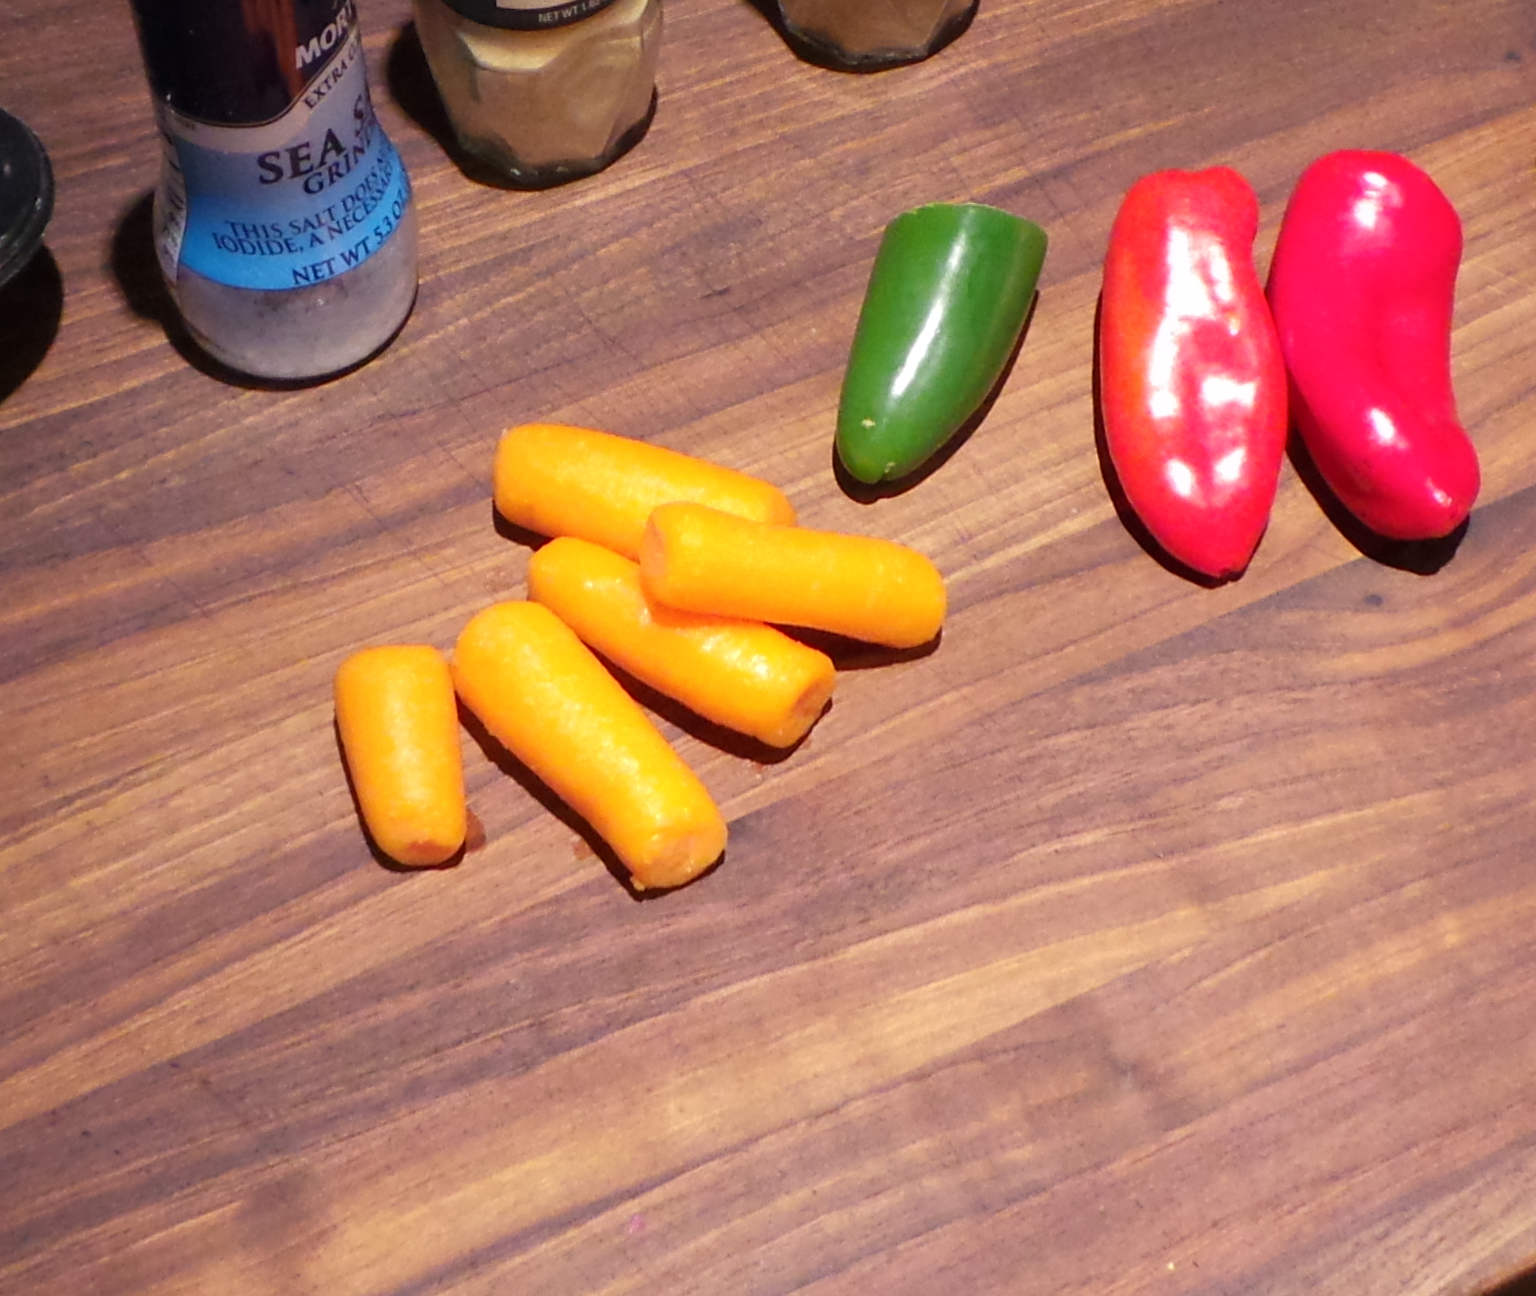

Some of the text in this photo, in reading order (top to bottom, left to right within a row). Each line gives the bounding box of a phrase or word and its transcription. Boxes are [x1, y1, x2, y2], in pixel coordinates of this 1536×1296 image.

[538, 10, 560, 24] NET
[562, 6, 578, 19] WT
[303, 59, 348, 111] EXTRA
[257, 127, 347, 187] SEA
[213, 230, 304, 256] IODIDE,
[308, 231, 324, 251] A
[226, 219, 283, 241] THIS
[288, 204, 337, 235] SALT
[291, 257, 337, 287] NET
[339, 235, 371, 267] WT
[373, 215, 393, 246] 5.3
